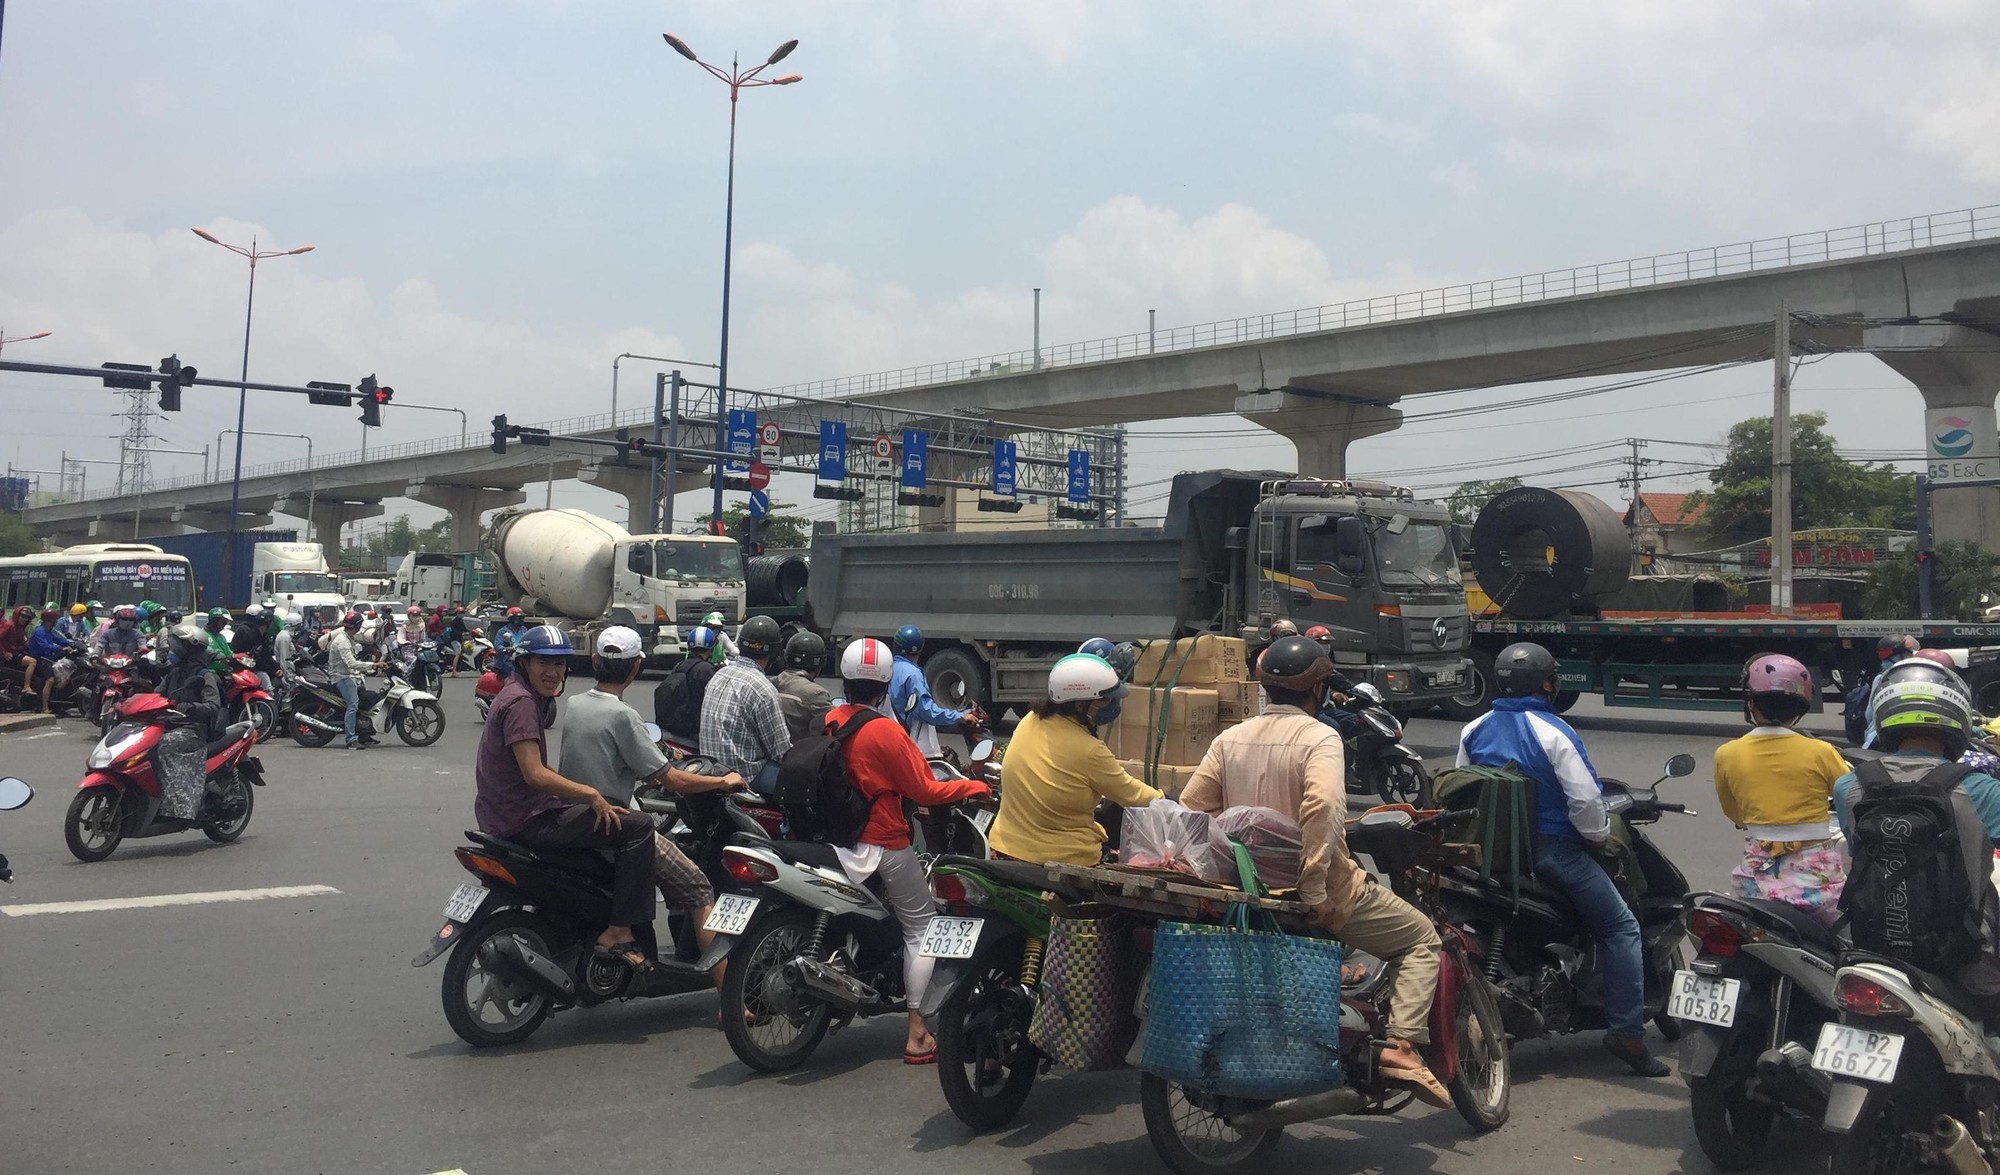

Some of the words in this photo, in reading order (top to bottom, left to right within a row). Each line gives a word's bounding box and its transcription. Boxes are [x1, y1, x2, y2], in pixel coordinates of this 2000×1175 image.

[765, 430, 777, 441] 80
[878, 442, 888, 453] 60
[1928, 464, 1949, 479] GS
[1953, 462, 1986, 478] E&C
[1953, 627, 1984, 636] CIMC
[1986, 627, 2000, 636] SH
[459, 884, 484, 903] 59-S1
[719, 898, 752, 915] 59-X3
[707, 912, 747, 932] 276.92
[934, 920, 974, 937] 59-S2
[923, 937, 973, 955] 503.28
[1682, 976, 1728, 1001] 64-E1
[1674, 995, 1731, 1023] 105.82
[1831, 1027, 1891, 1056] 71-B2
[1819, 1047, 1893, 1078] 166.77
